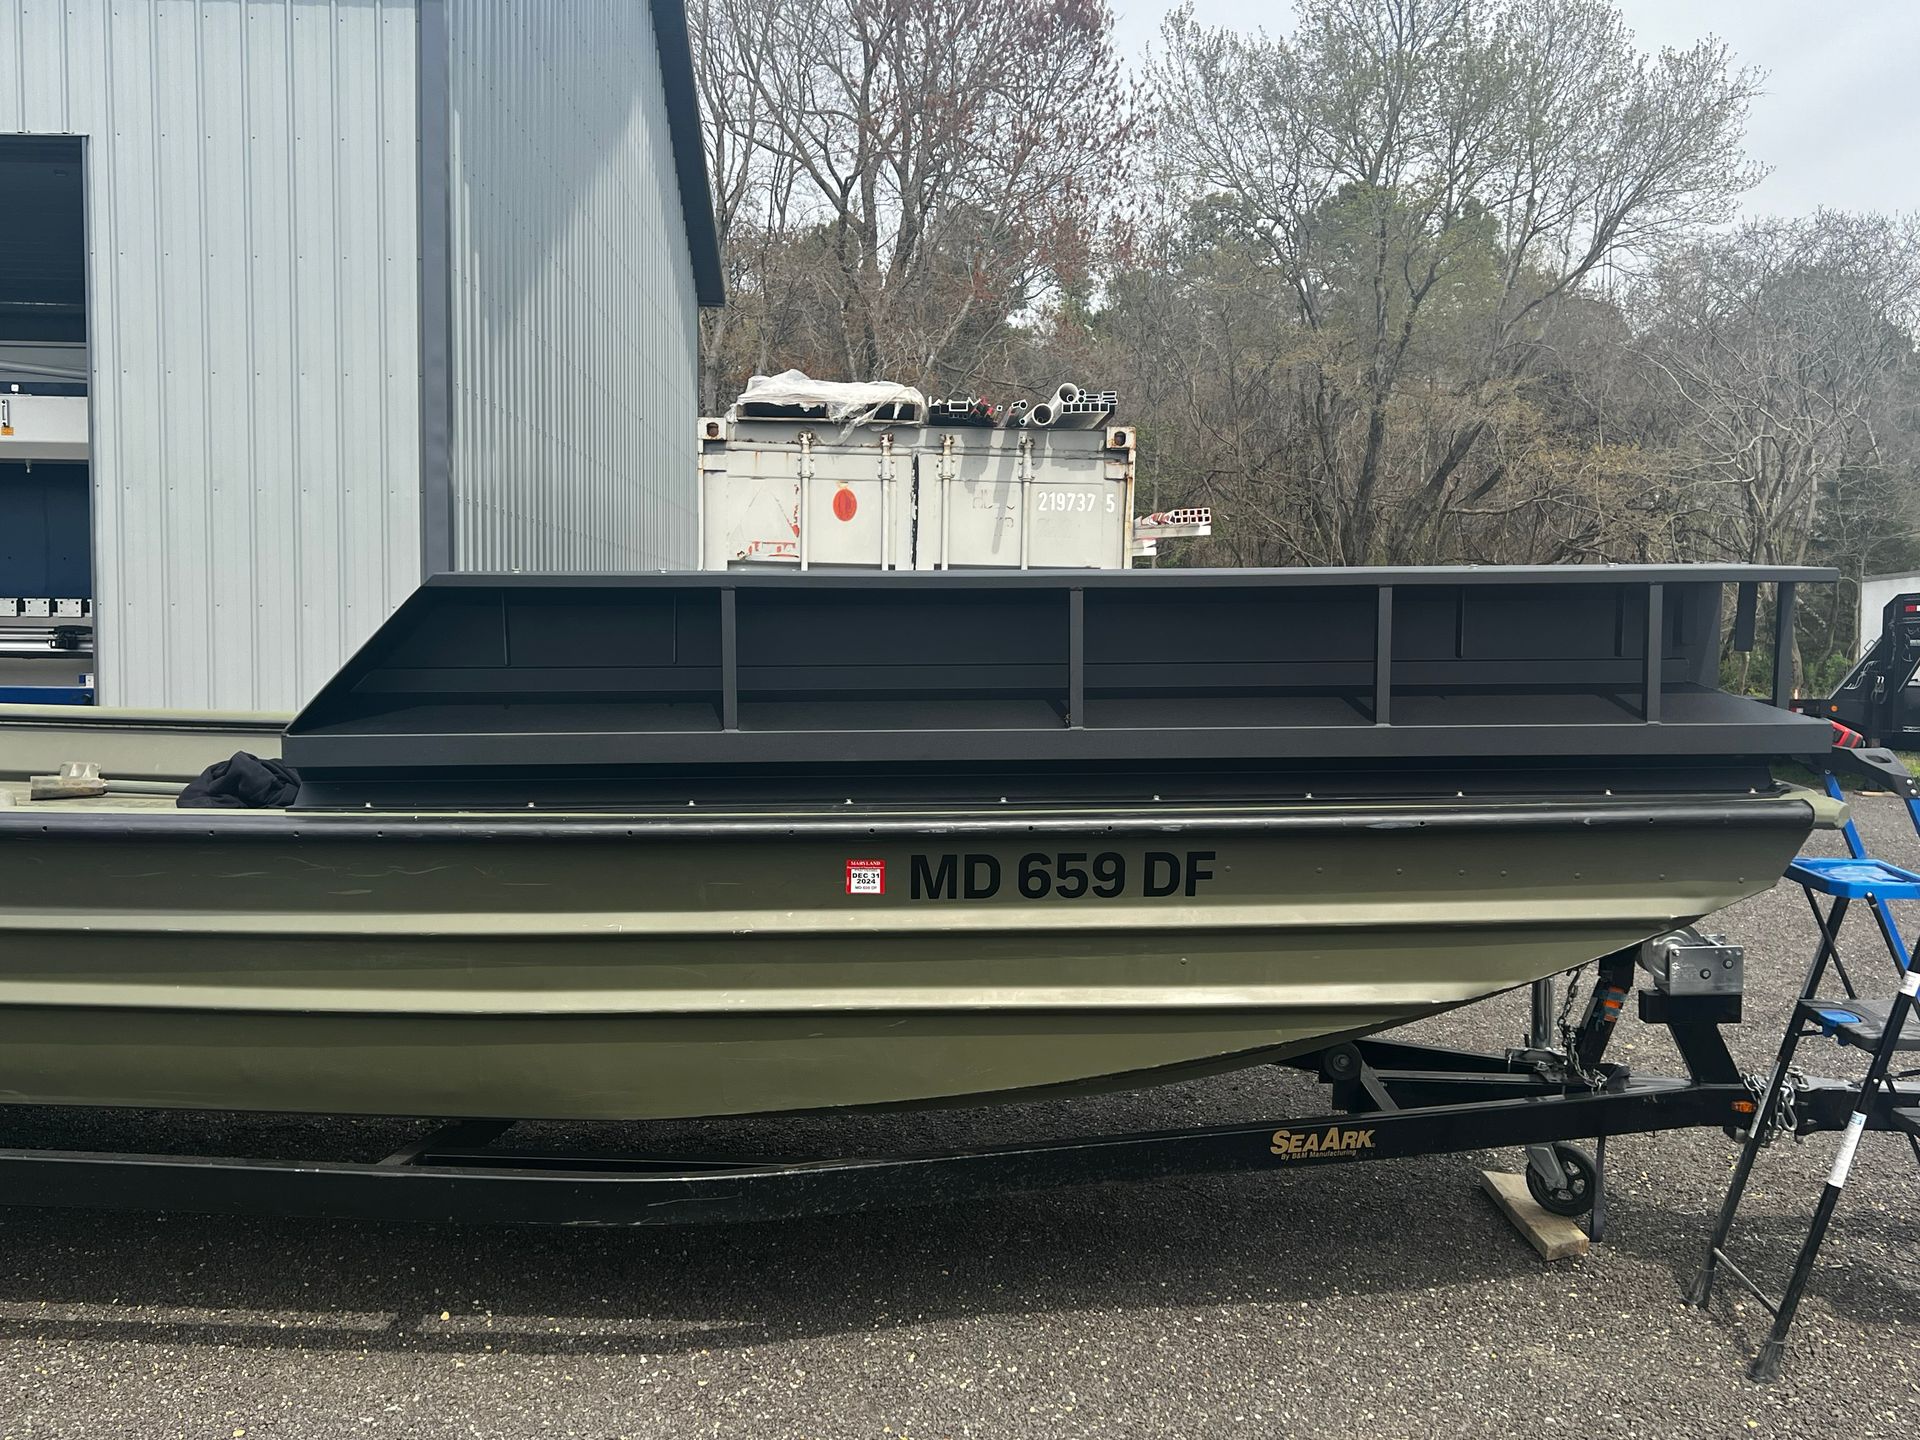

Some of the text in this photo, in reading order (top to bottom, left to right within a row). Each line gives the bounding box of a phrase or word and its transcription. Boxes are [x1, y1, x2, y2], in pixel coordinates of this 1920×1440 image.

[1038, 492, 1096, 512] 219737
[1106, 493, 1115, 513] 5
[910, 851, 1216, 899] MD 659 DF
